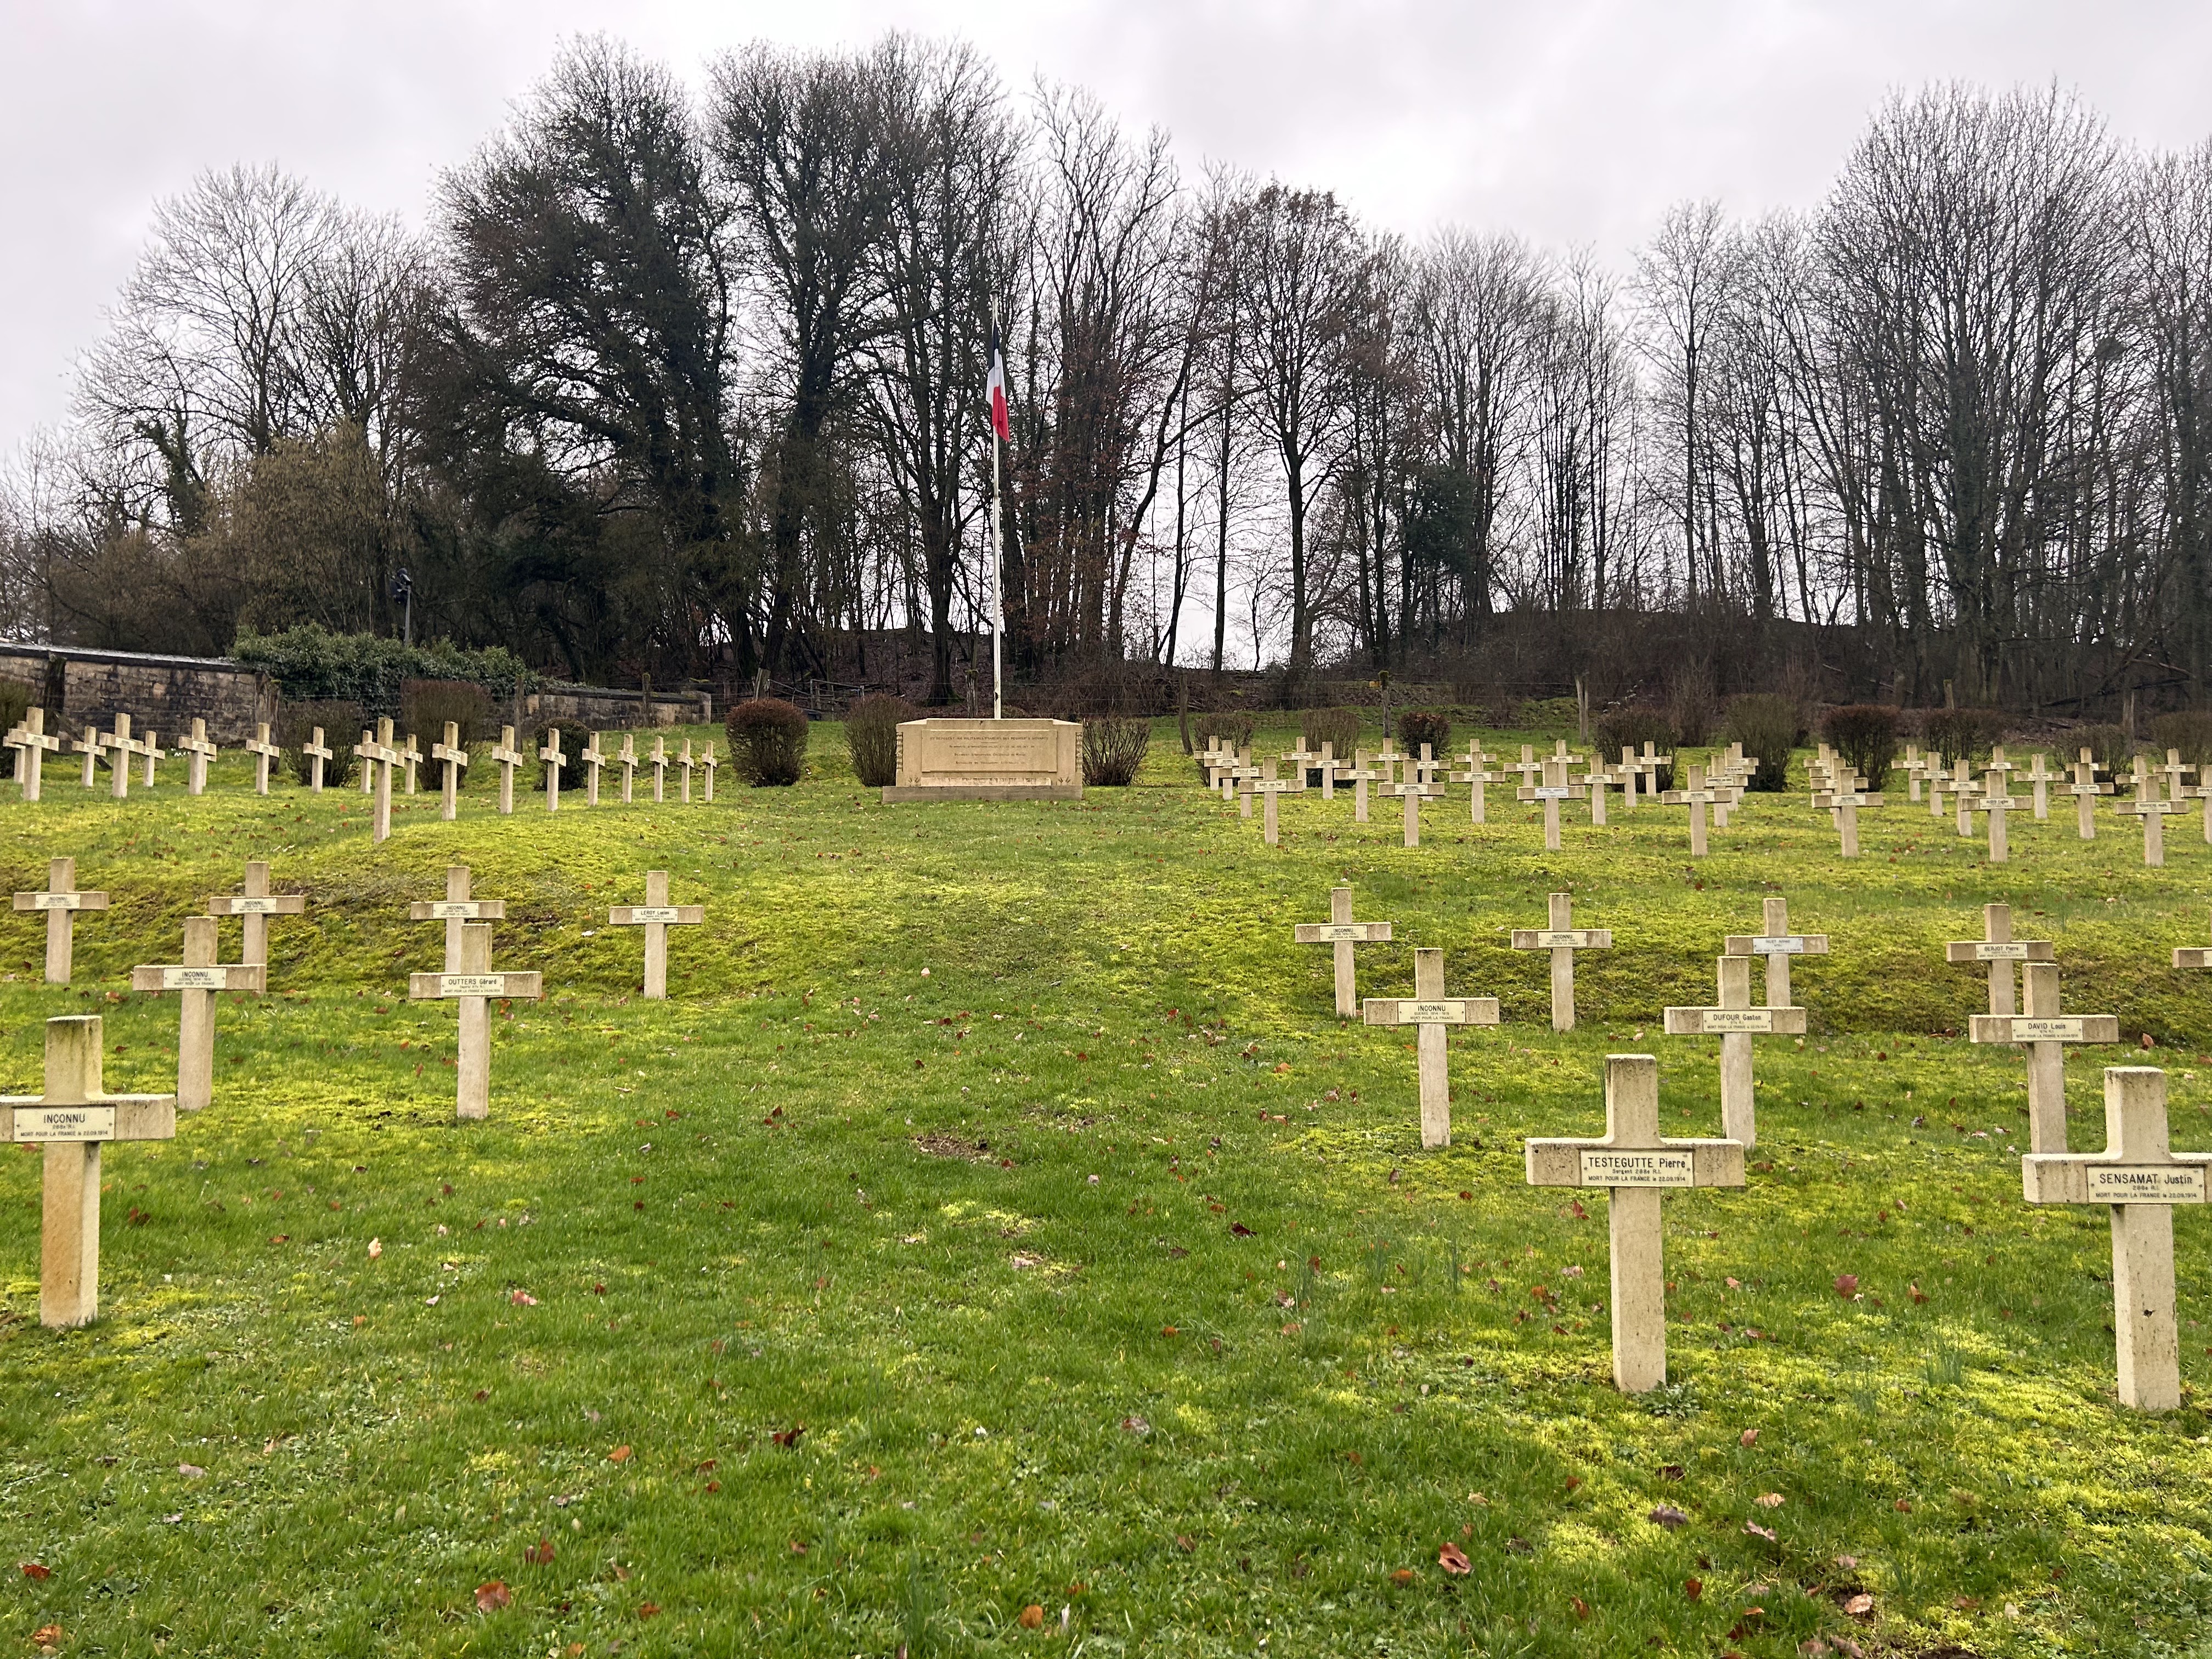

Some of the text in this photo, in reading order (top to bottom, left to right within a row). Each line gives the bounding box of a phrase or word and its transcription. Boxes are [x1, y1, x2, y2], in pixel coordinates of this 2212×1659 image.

[43, 1114, 86, 1124] INCONNU
[1588, 1156, 1685, 1168] TESTEGUTTE Pierre
[2099, 1173, 2192, 1184] SENSAMAT Justin
